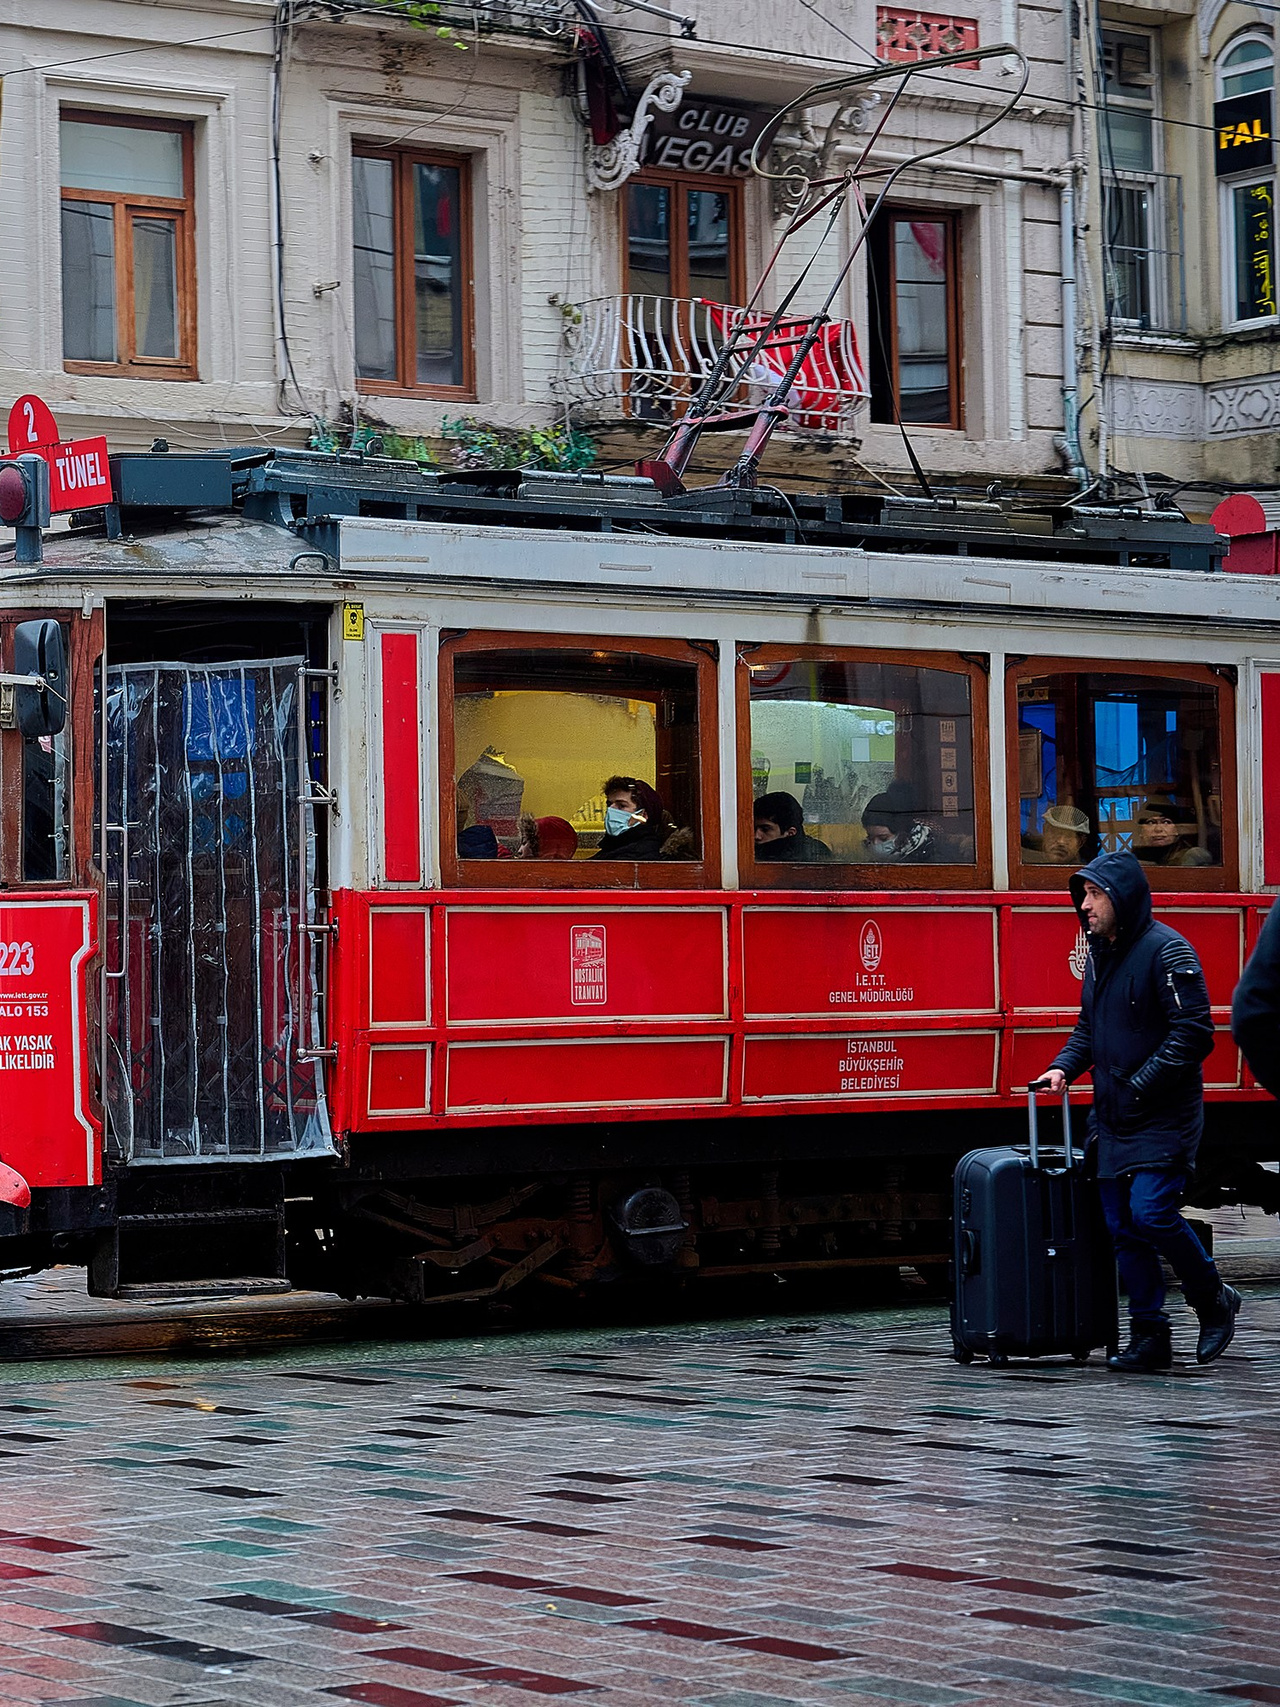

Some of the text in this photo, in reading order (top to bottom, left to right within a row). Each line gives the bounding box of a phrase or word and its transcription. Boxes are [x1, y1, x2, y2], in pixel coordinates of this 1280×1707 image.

[679, 109, 750, 138] CLUB
[1219, 119, 1269, 149] FAL
[23, 402, 38, 443] 2
[55, 447, 106, 491] TÜNEL
[856, 973, 886, 986] İ.E.T.T.
[574, 985, 604, 1000] TRAMVAY
[829, 987, 914, 1003] GENEL MÜDÜRLÜĞÜ
[26, 1005, 49, 1017] 153
[14, 1035, 53, 1051] YASAK
[847, 1039, 897, 1054] İSTANBUL
[838, 1056, 904, 1072] BÜYÜKŞEHİR
[841, 1074, 900, 1090] BELEDİYESİ
